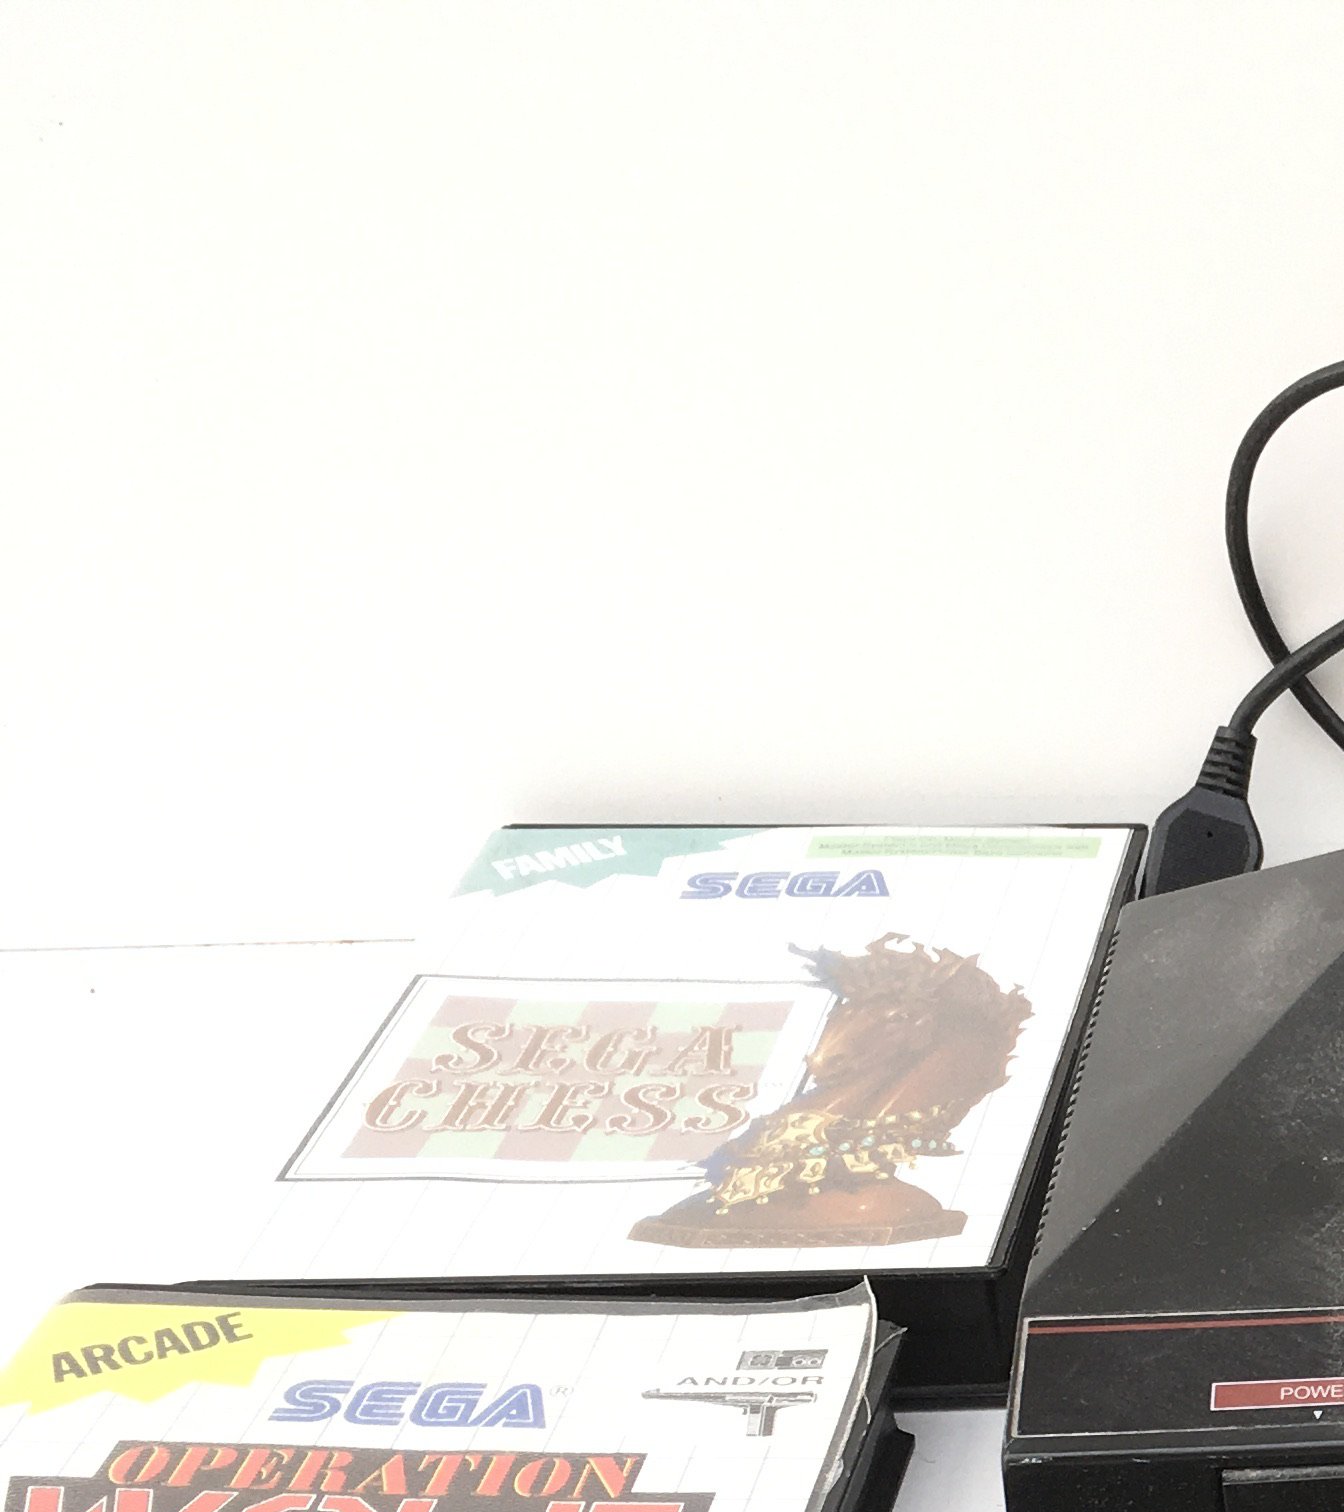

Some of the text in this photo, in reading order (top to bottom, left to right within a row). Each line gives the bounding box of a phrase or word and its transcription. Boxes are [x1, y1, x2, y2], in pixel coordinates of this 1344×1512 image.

[491, 835, 630, 882] FAMILY
[679, 869, 890, 899] SEGA
[429, 1020, 740, 1077] SEGA
[362, 1079, 758, 1136] CHESS
[50, 1312, 254, 1384] ARCADE
[267, 1381, 546, 1428] SEGA
[677, 1375, 826, 1387] AND/OR
[108, 1444, 637, 1499] OPERATION
